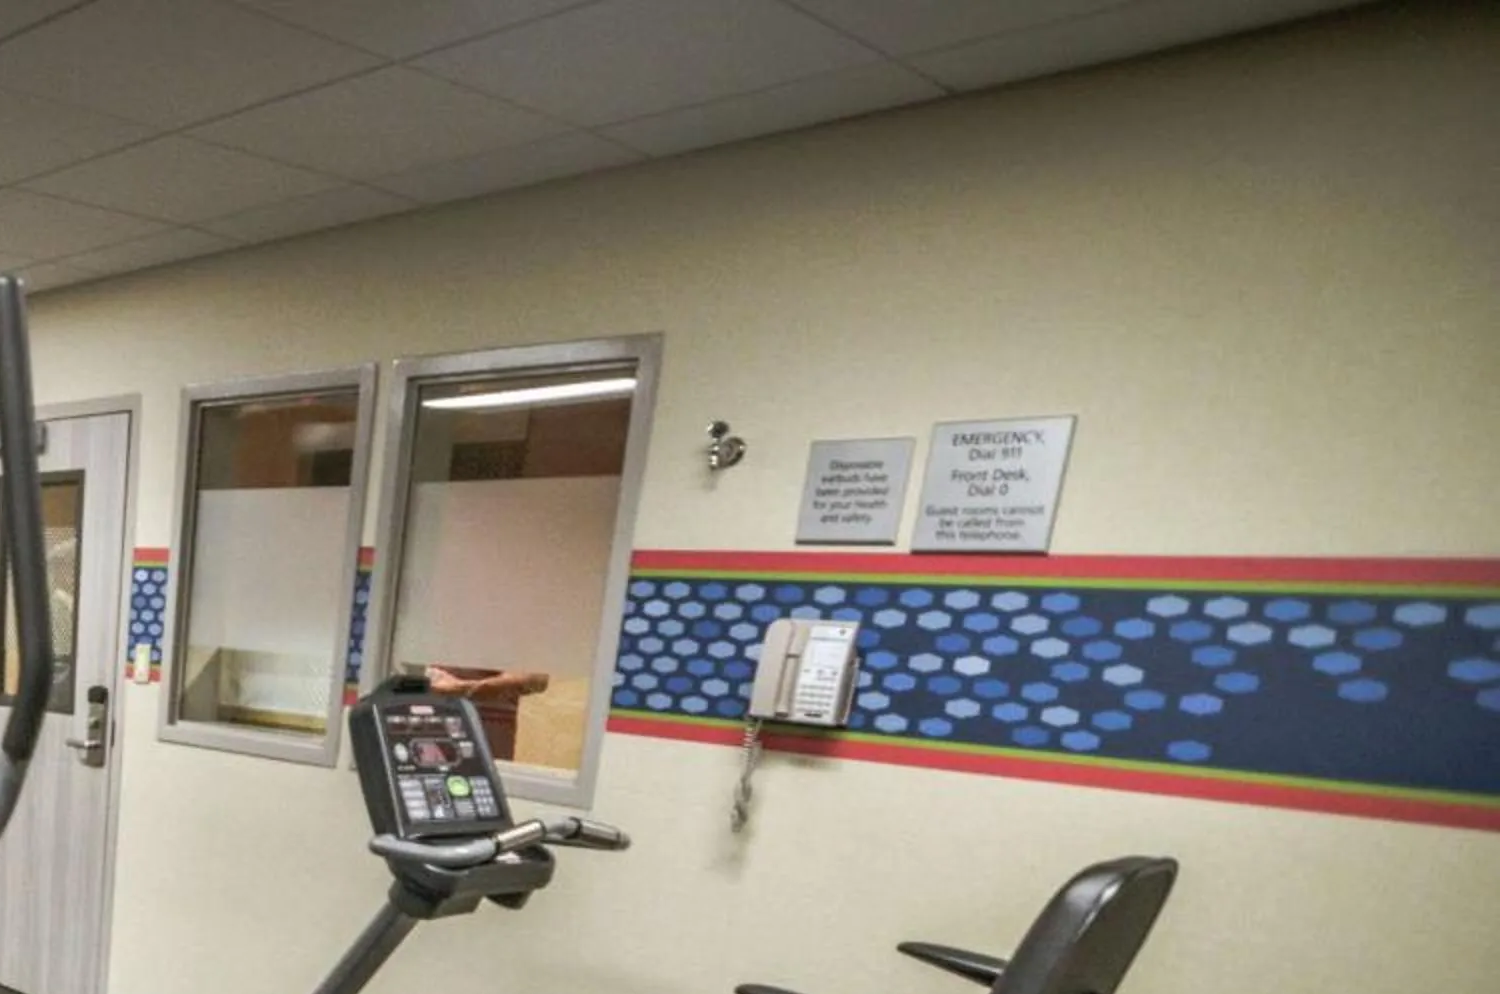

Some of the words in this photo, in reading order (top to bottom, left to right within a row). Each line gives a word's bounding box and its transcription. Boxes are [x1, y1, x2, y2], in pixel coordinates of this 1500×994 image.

[968, 447, 997, 461] Dial
[1002, 446, 1023, 460] 911
[951, 468, 989, 482] Front
[967, 482, 996, 497] Dial
